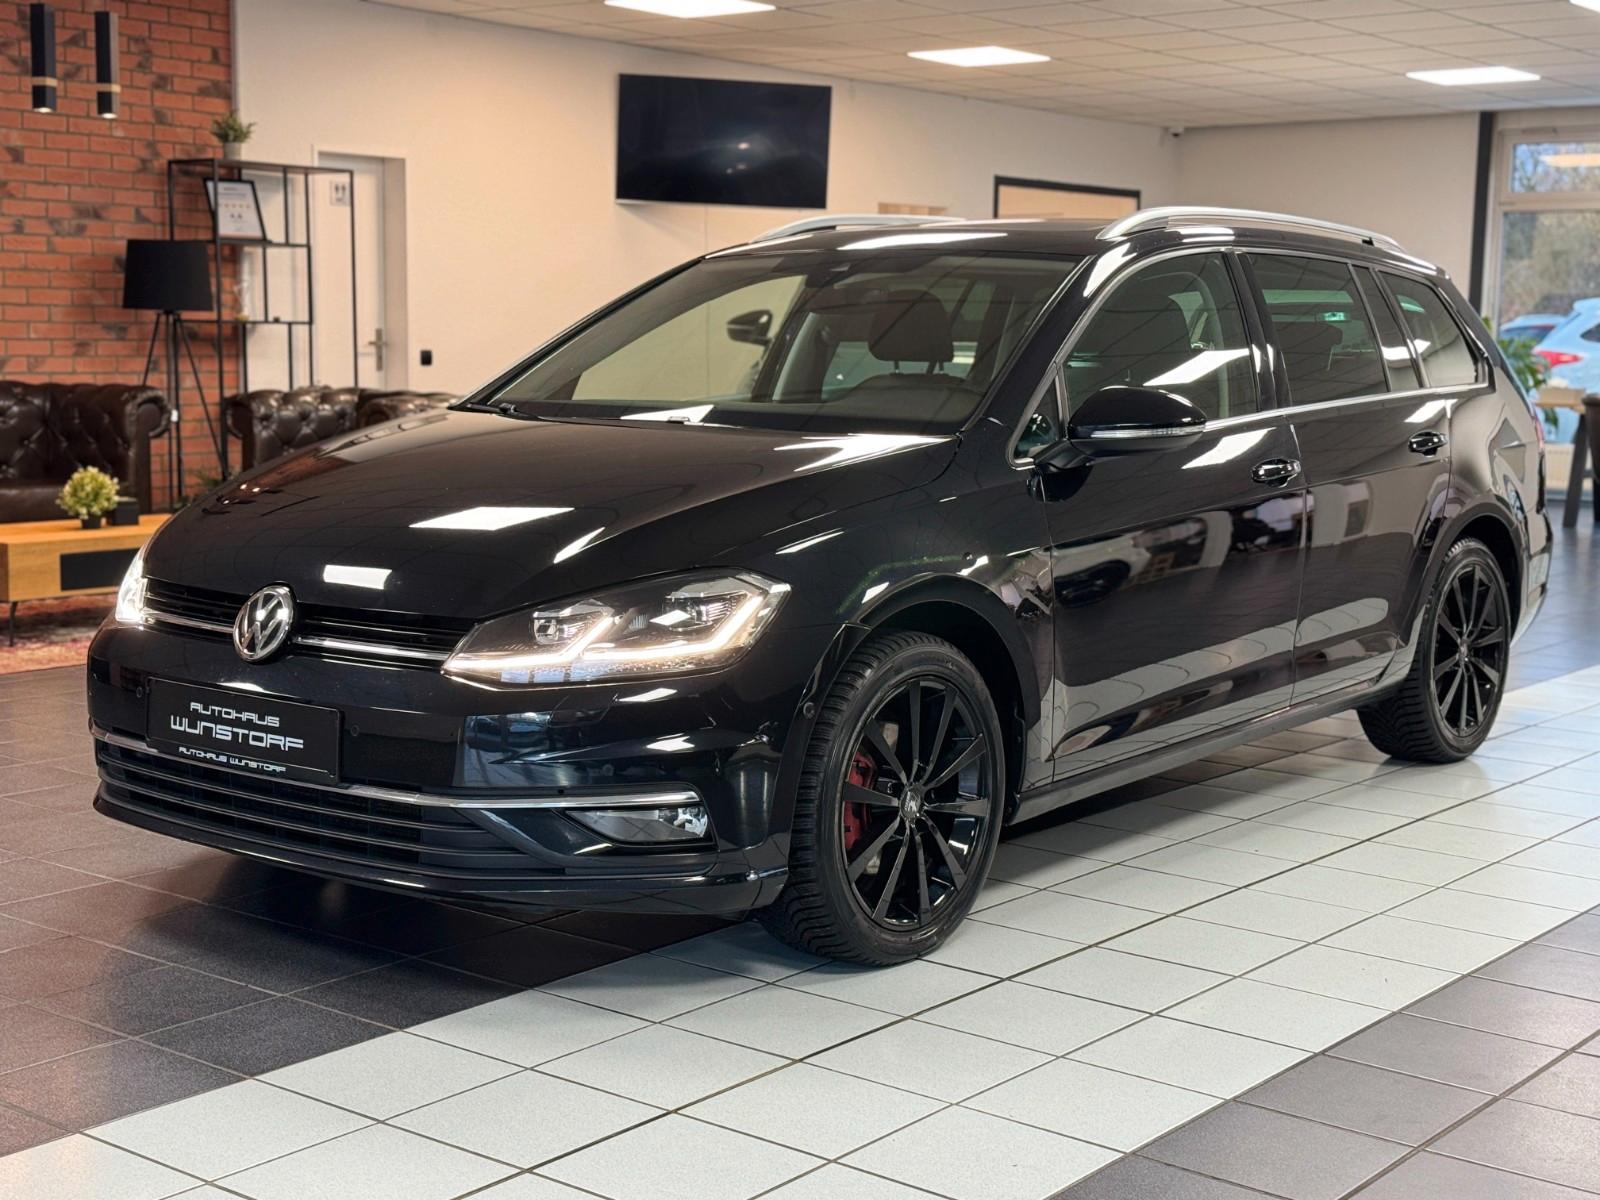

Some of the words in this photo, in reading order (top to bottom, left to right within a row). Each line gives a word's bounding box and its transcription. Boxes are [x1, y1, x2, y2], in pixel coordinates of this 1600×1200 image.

[233, 585, 293, 661] VW
[190, 702, 280, 727] AUTOHAUS
[170, 714, 304, 751] WUNSTORF
[179, 746, 228, 763] AUTOHAUS
[229, 757, 287, 773] WUNSTORF
